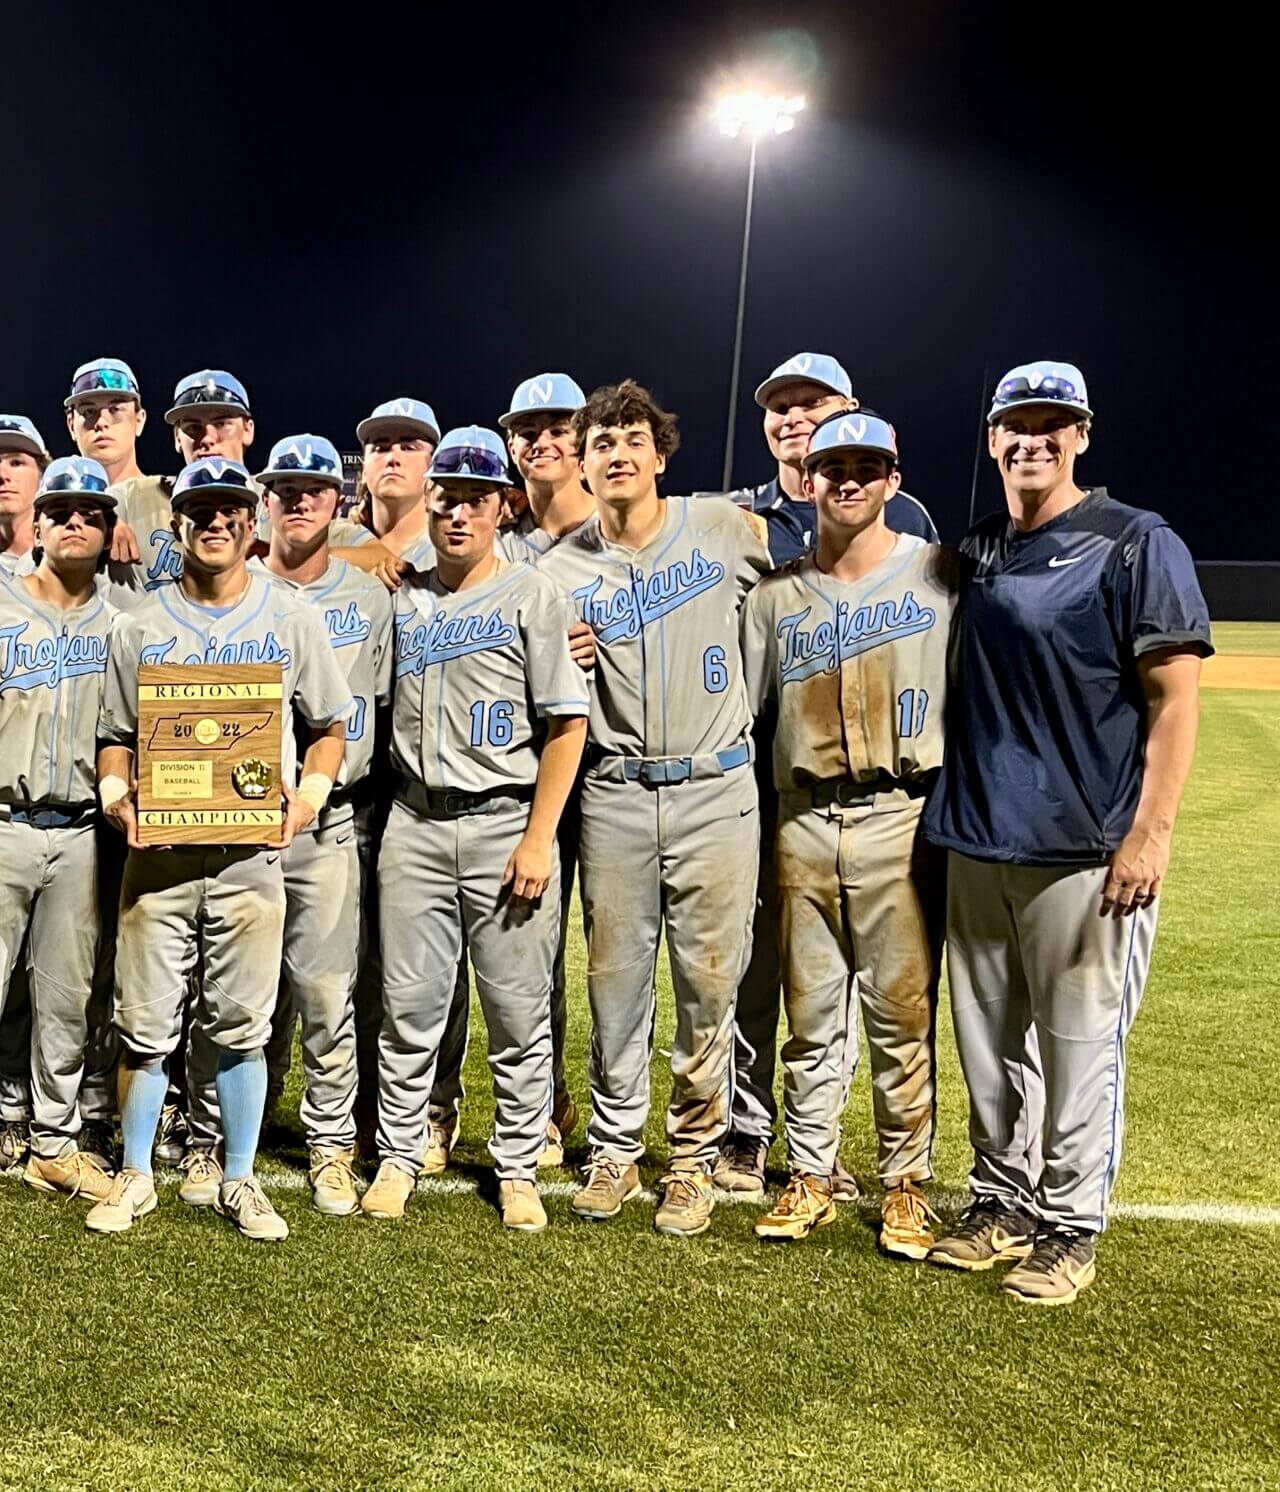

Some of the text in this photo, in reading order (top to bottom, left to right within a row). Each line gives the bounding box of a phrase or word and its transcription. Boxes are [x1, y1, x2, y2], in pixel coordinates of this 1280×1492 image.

[528, 382, 552, 404] N
[837, 418, 866, 442] N
[572, 548, 725, 646] Trojans
[777, 591, 935, 688] Trojans
[703, 646, 729, 694] 6
[156, 685, 267, 698] REGIONAL
[174, 723, 192, 737] 20
[222, 722, 241, 737] 22
[470, 700, 514, 746] 16
[145, 812, 275, 825] CHAMPIONS
